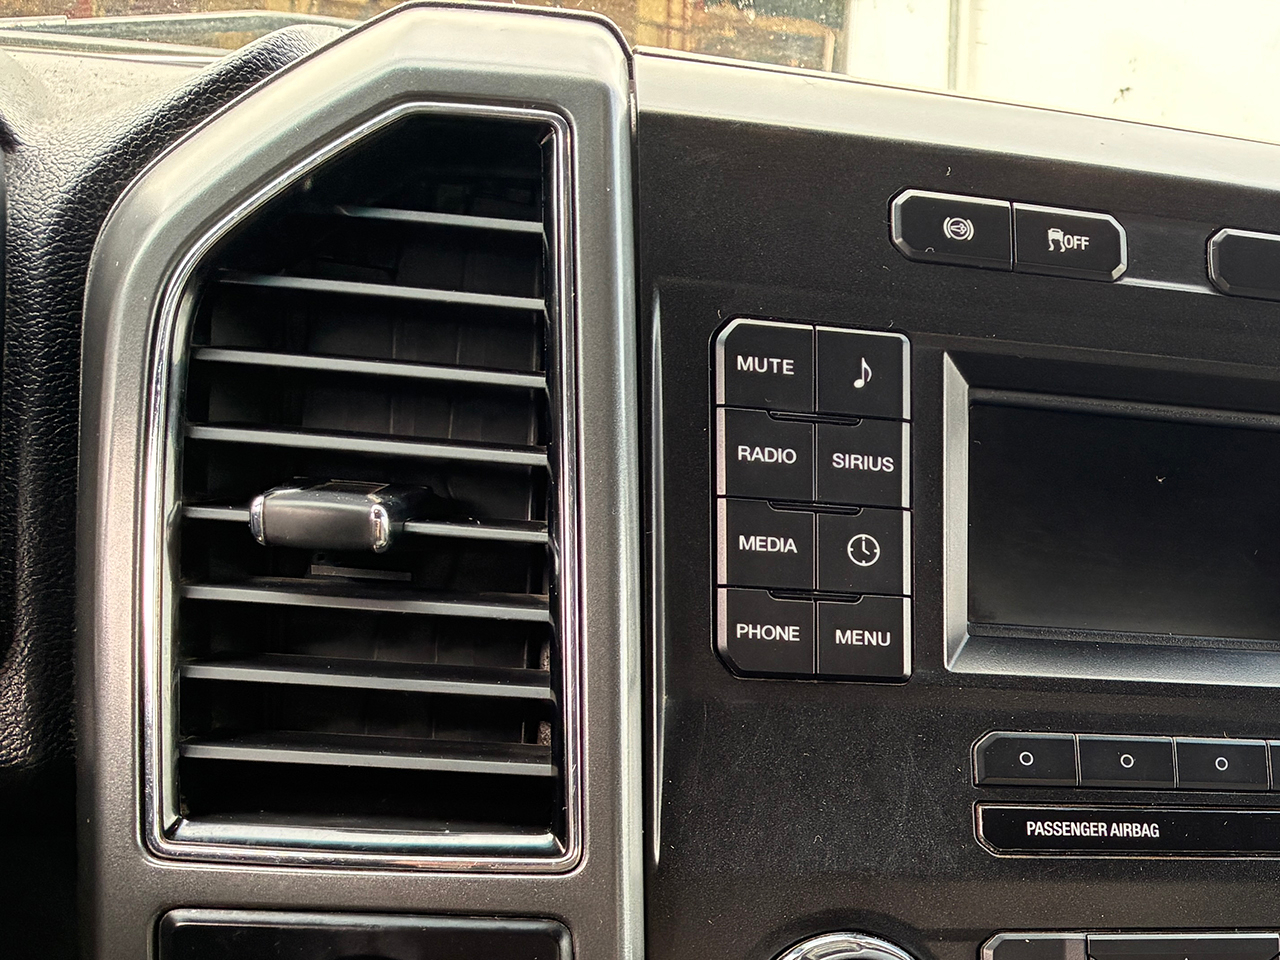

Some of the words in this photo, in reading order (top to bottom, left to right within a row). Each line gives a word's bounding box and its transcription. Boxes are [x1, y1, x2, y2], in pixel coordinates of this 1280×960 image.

[1064, 234, 1090, 250] OFF
[737, 355, 795, 375] MUTE
[737, 445, 797, 464] RADIO
[832, 452, 895, 473] SIRIUS
[738, 534, 798, 554] MEDIA
[736, 623, 801, 642] PHONE
[835, 629, 891, 647] MENU
[1026, 821, 1108, 837] PASSENGER
[1109, 822, 1160, 838] AIRBAG
